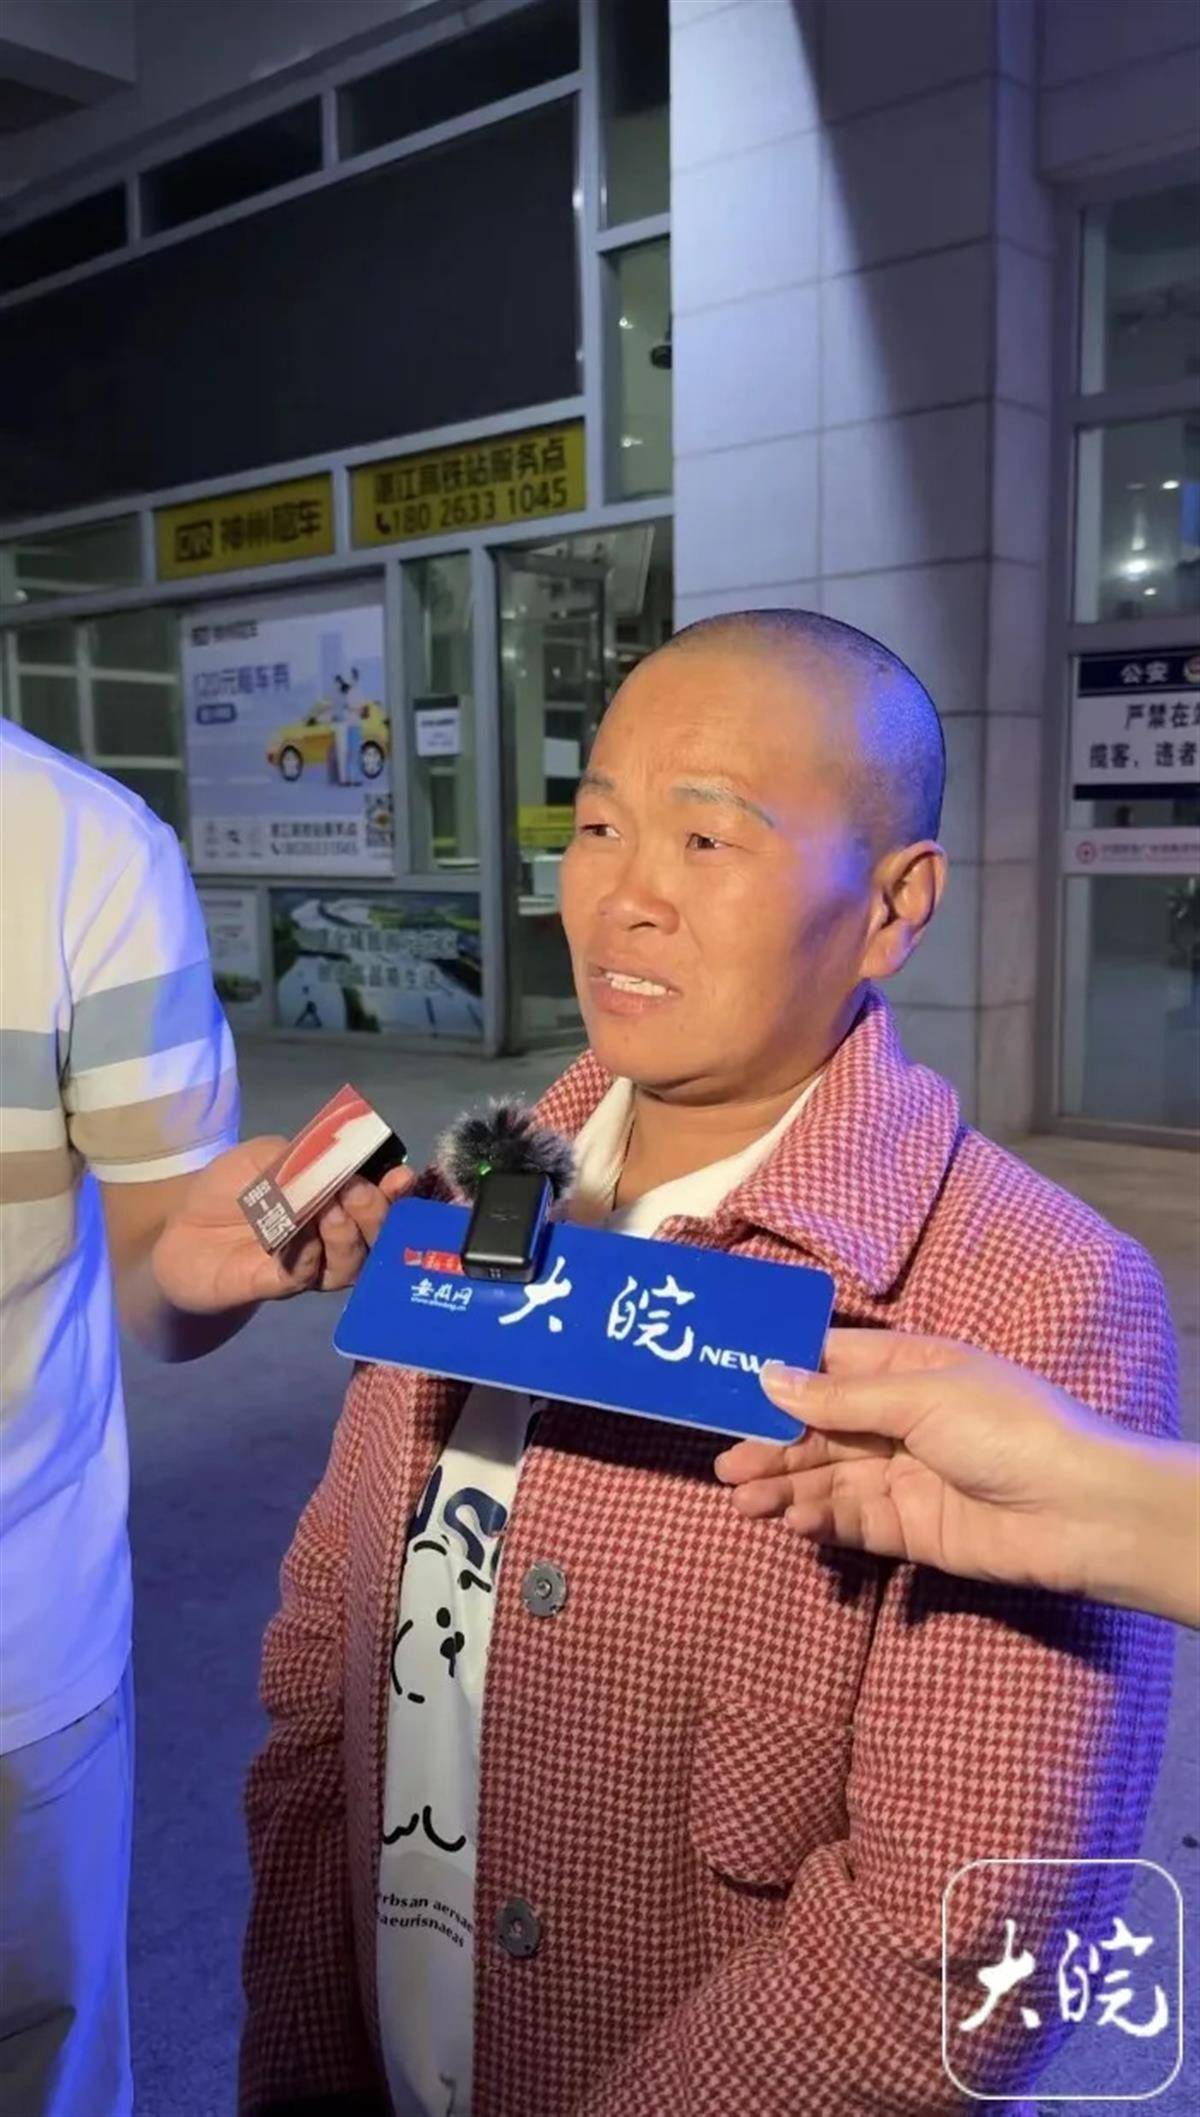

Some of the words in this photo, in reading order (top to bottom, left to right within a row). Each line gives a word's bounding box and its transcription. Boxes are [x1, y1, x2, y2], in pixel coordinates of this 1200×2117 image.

[391, 503, 431, 534] 180
[439, 490, 496, 528] 2633
[507, 476, 569, 515] 1045
[1121, 661, 1168, 684] 公安
[500, 1256, 695, 1361] 大皖
[699, 1345, 785, 1374] NEW
